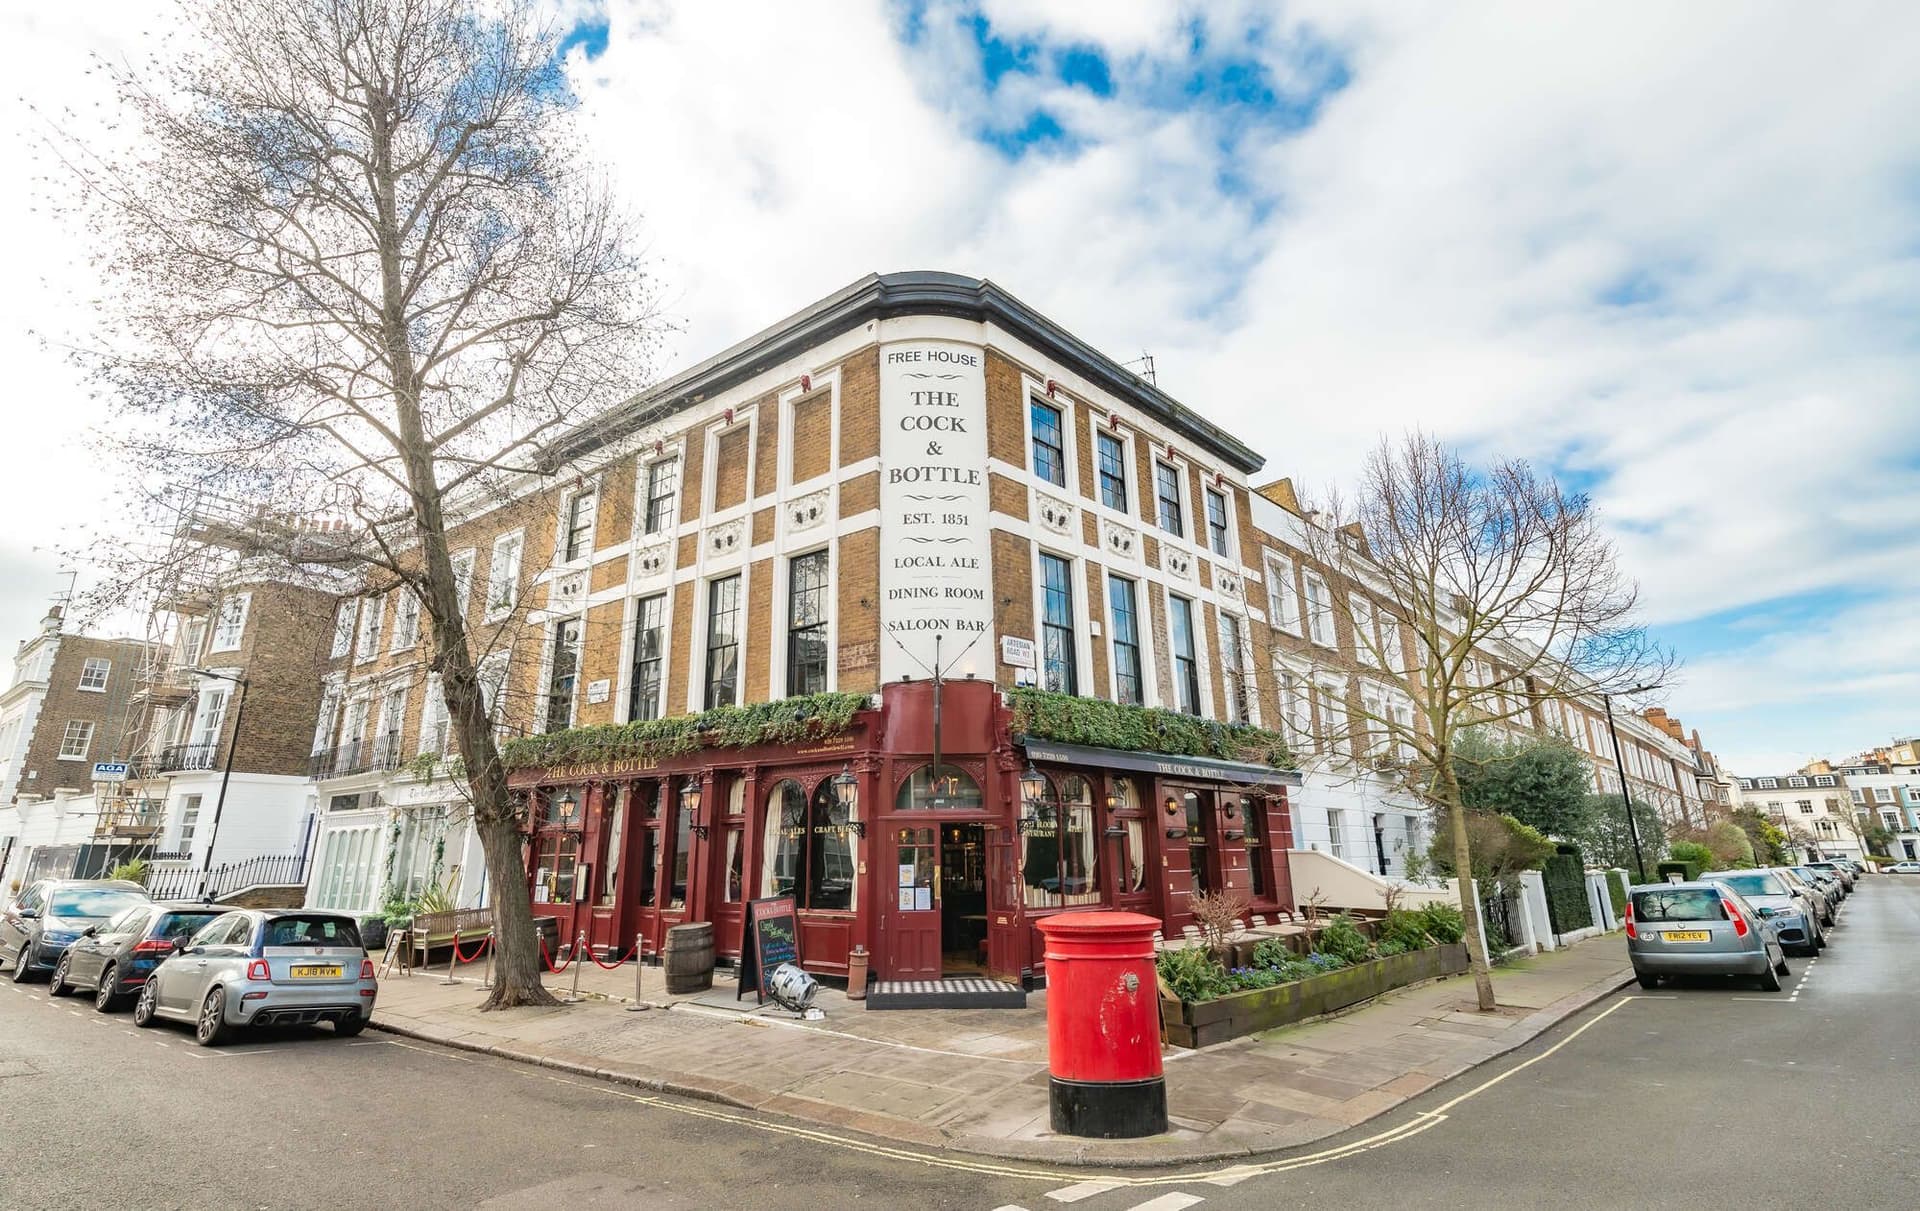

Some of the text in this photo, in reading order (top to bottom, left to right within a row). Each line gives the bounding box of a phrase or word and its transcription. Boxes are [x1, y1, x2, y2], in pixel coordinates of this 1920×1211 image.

[888, 351, 977, 367] FREE HOUSE
[911, 391, 960, 407] THE
[900, 415, 967, 433] COCK
[926, 440, 943, 456] &
[889, 467, 981, 486] BOTTLE
[903, 513, 969, 526] EST. 1851
[894, 556, 980, 570] LOCAL ALE
[889, 586, 984, 600] DINING ROOM
[888, 618, 985, 632] SALOON BAR
[547, 757, 658, 778] THE COCK & BOTTLE
[1157, 763, 1172, 774] THE
[1174, 764, 1194, 776] COCK
[947, 776, 959, 795] 17
[814, 826, 836, 834] CRAFT
